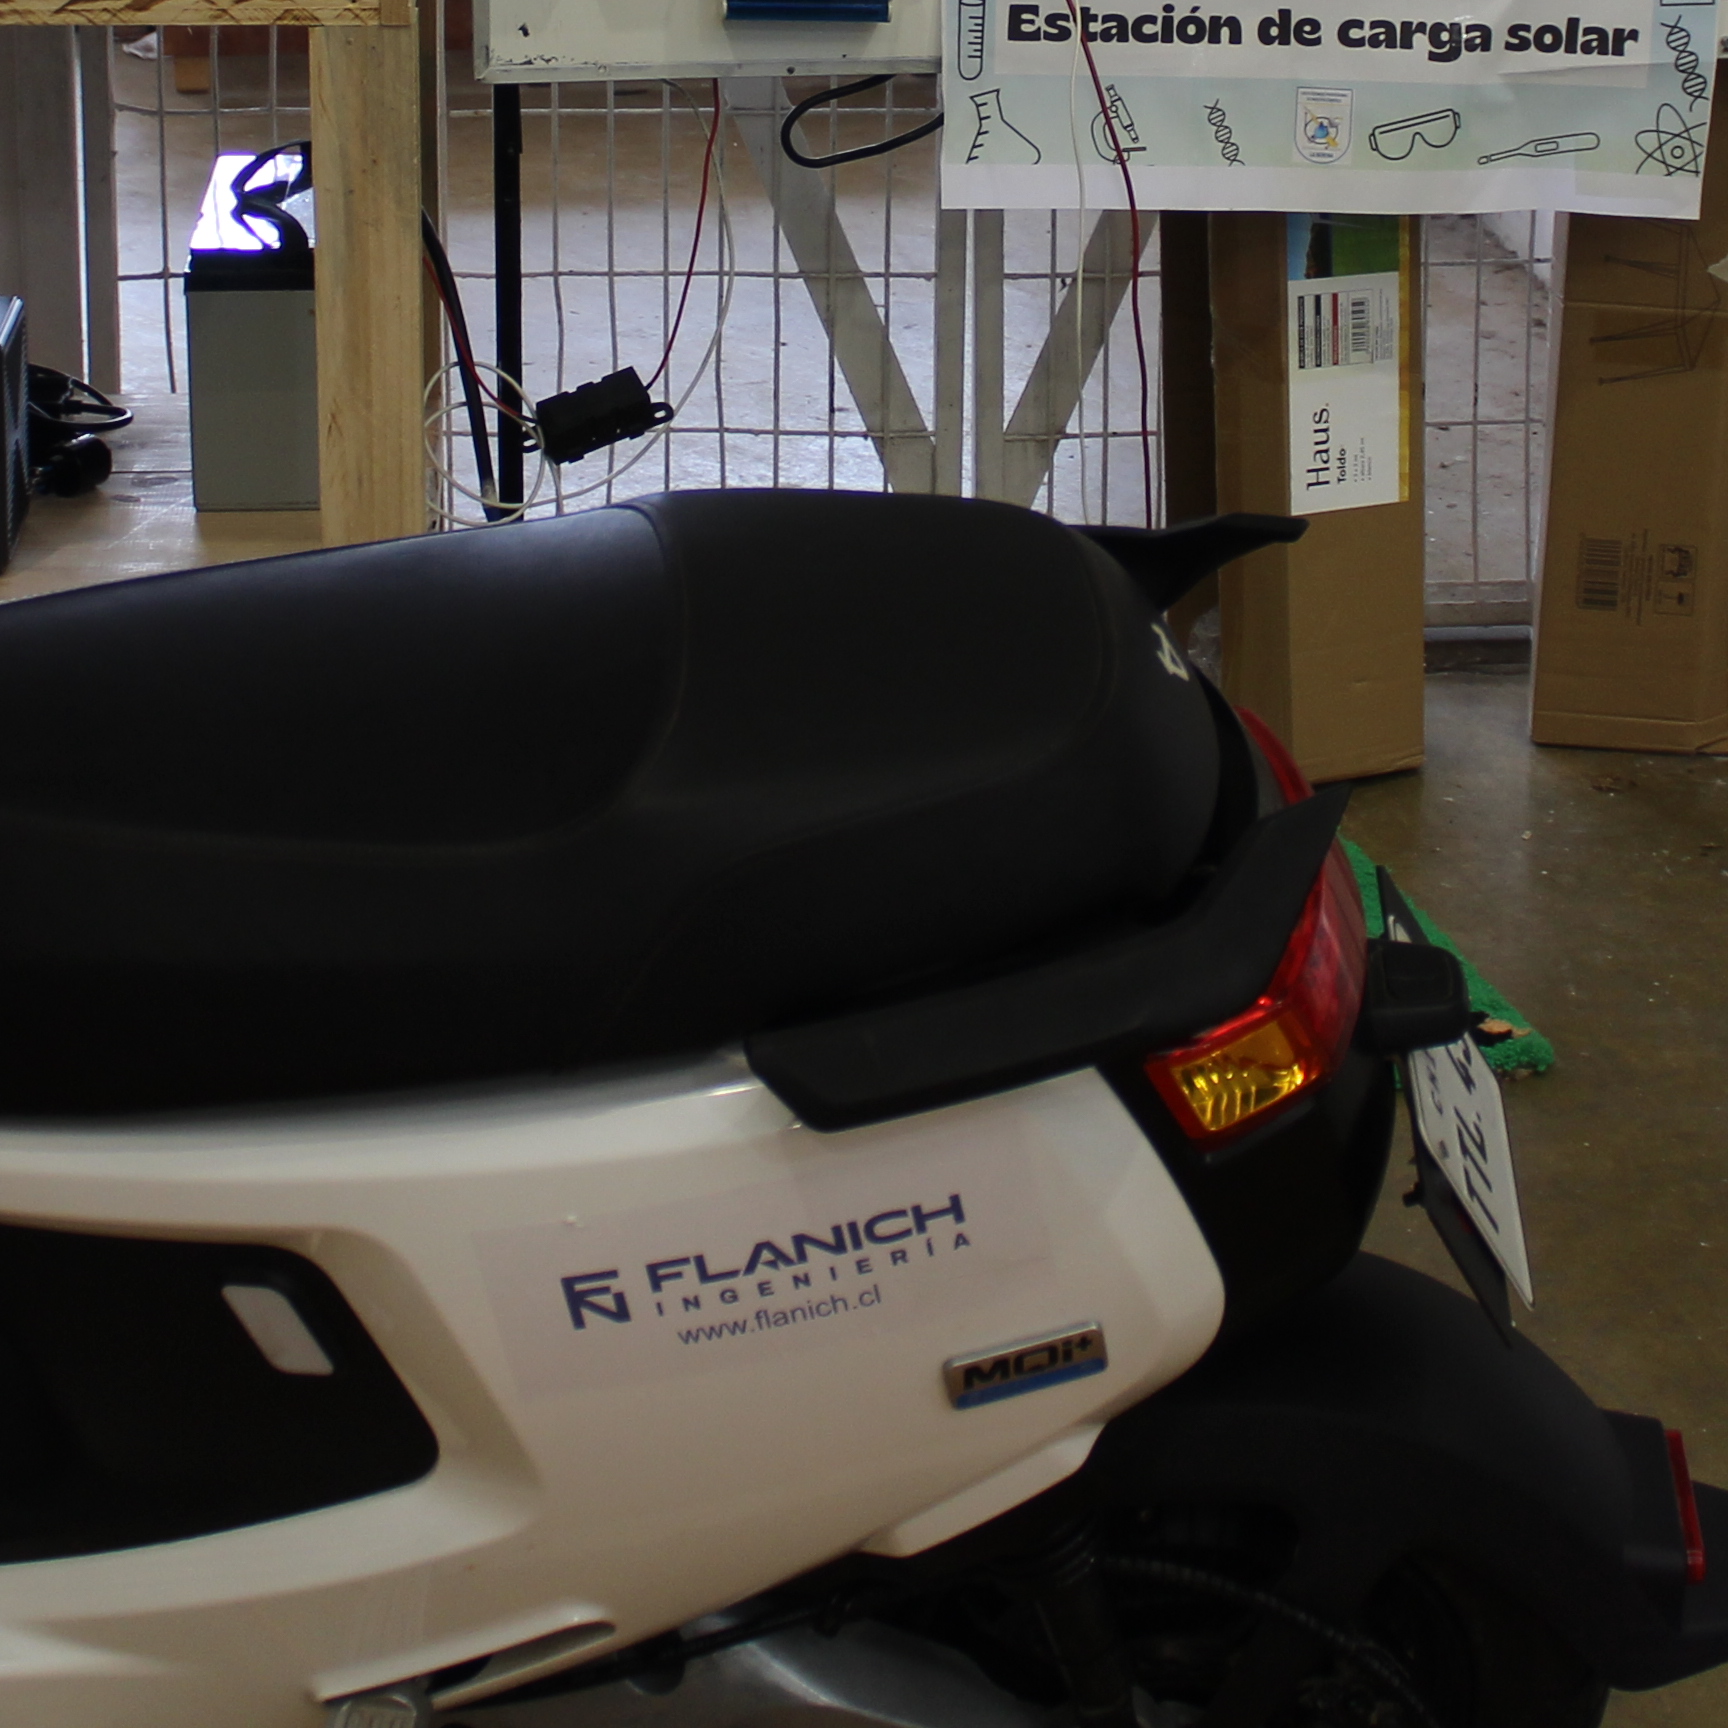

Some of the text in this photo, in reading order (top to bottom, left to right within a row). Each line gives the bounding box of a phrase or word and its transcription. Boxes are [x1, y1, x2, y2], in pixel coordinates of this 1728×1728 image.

[1006, 2, 1640, 64] Estación de carga solar
[1337, 448, 1347, 484] Toldo
[645, 1193, 967, 1294] FLANICH
[655, 1231, 971, 1318] INGENIERÍA
[676, 1284, 882, 1346] www.flanich.cl
